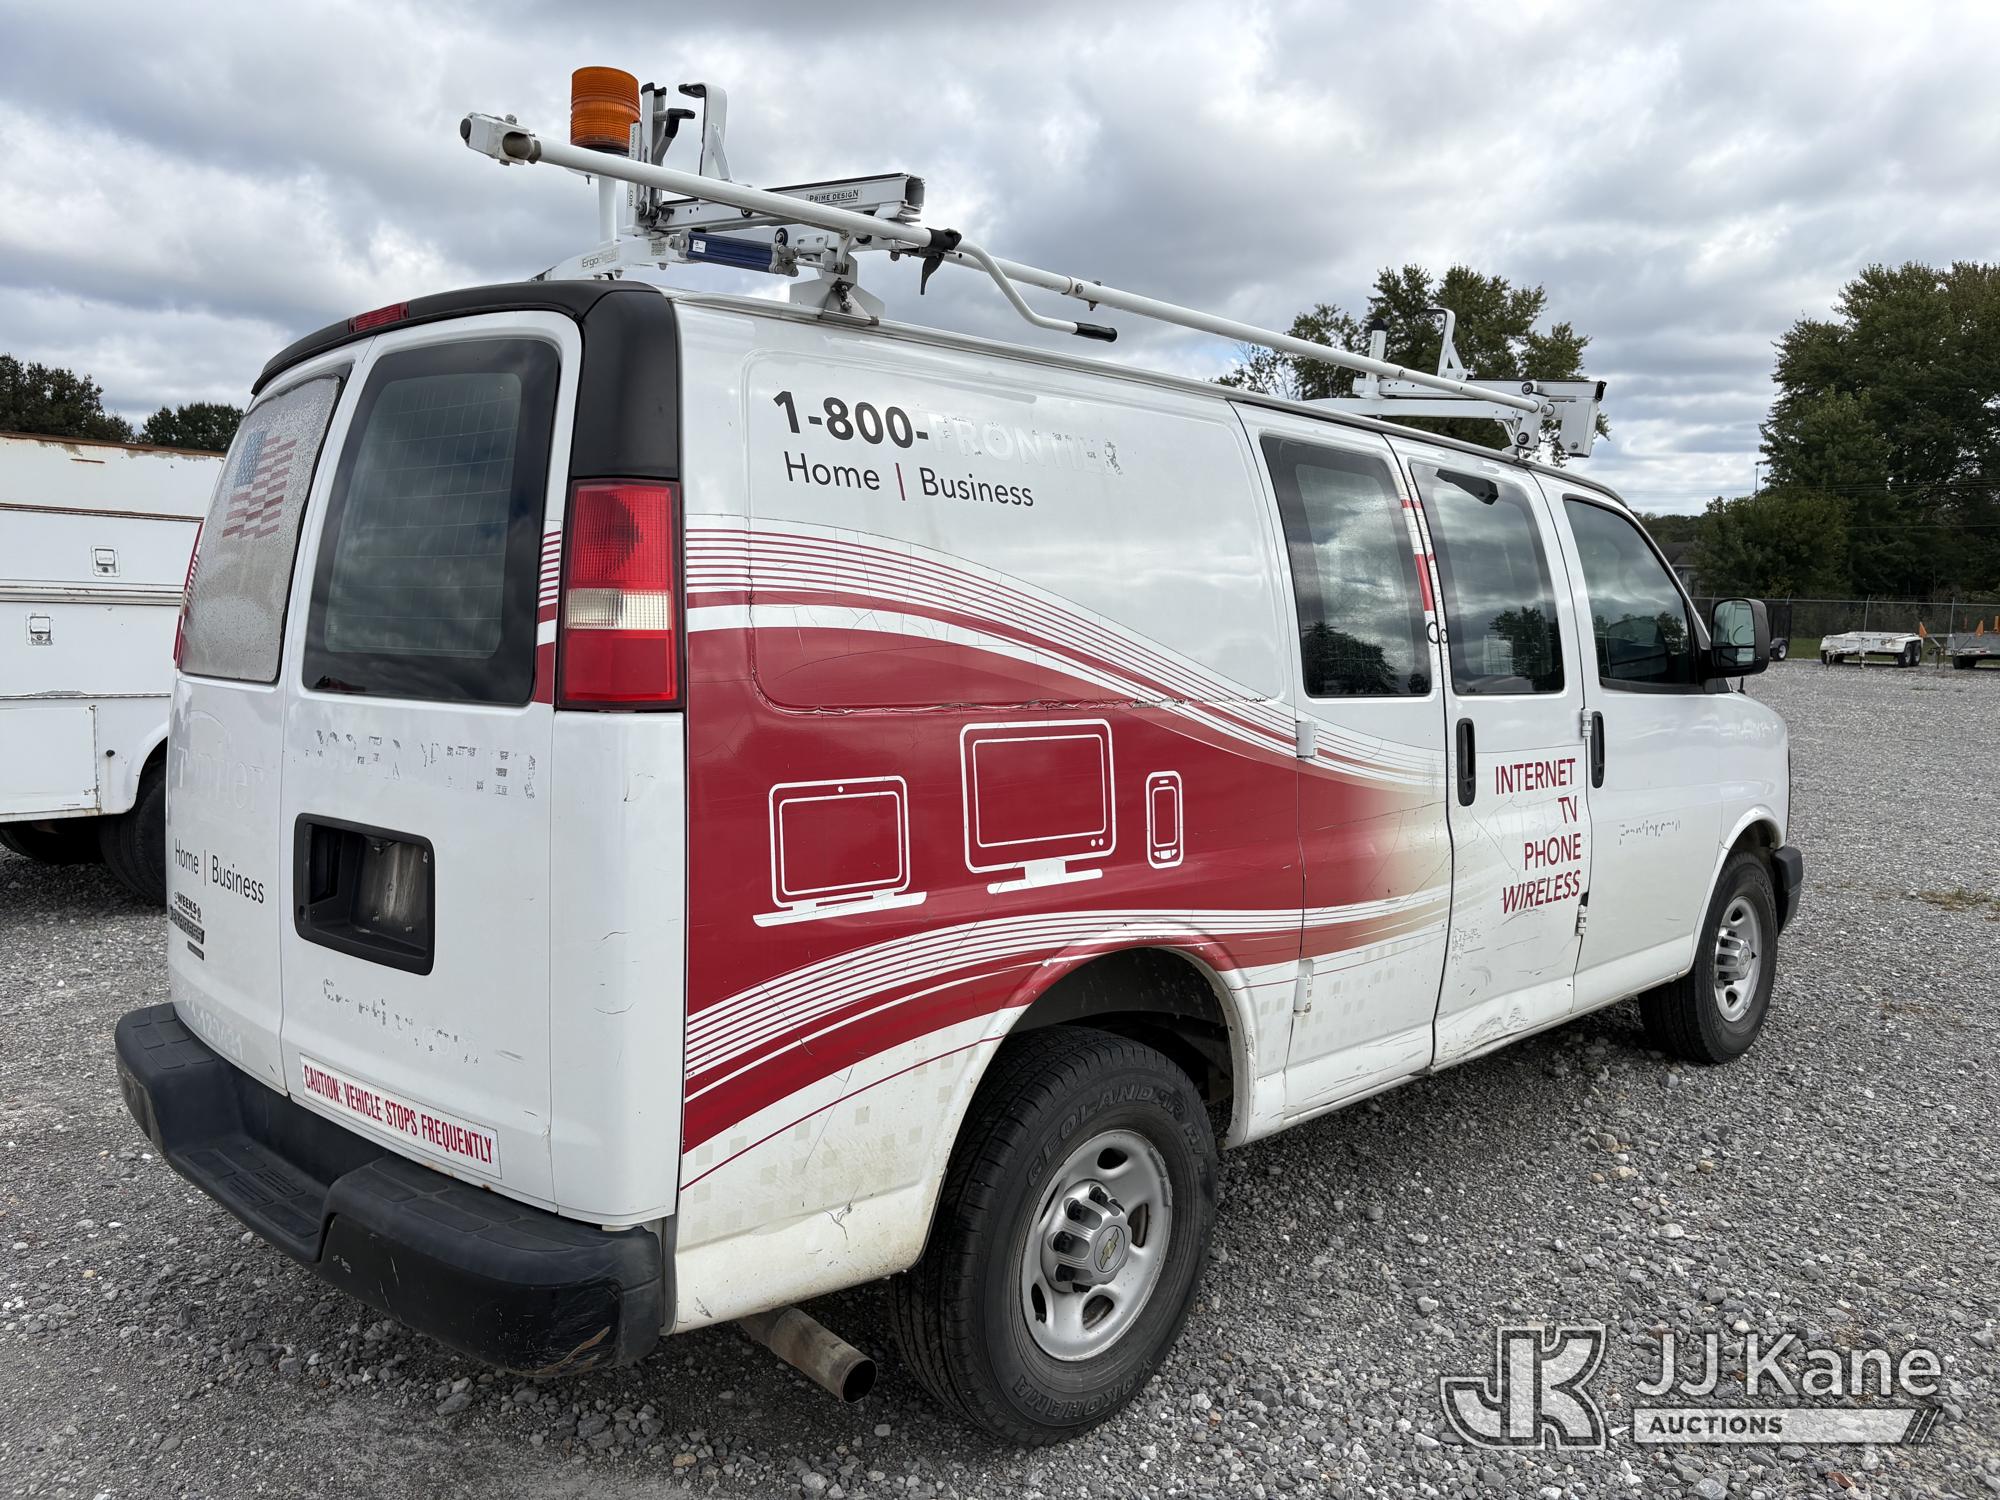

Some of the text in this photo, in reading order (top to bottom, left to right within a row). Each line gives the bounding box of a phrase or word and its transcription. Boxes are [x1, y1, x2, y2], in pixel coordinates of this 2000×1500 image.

[783, 450, 1034, 507] Home Business
[1495, 757, 1576, 795] INTERNET
[1557, 795, 1578, 824] TV
[174, 837, 265, 904] Home Business
[1524, 832, 1582, 871] PHONE
[1502, 869, 1581, 914] WIRELESS
[303, 1064, 493, 1164] CAUTION: VEHICLE STOPS FREQUENTLY
